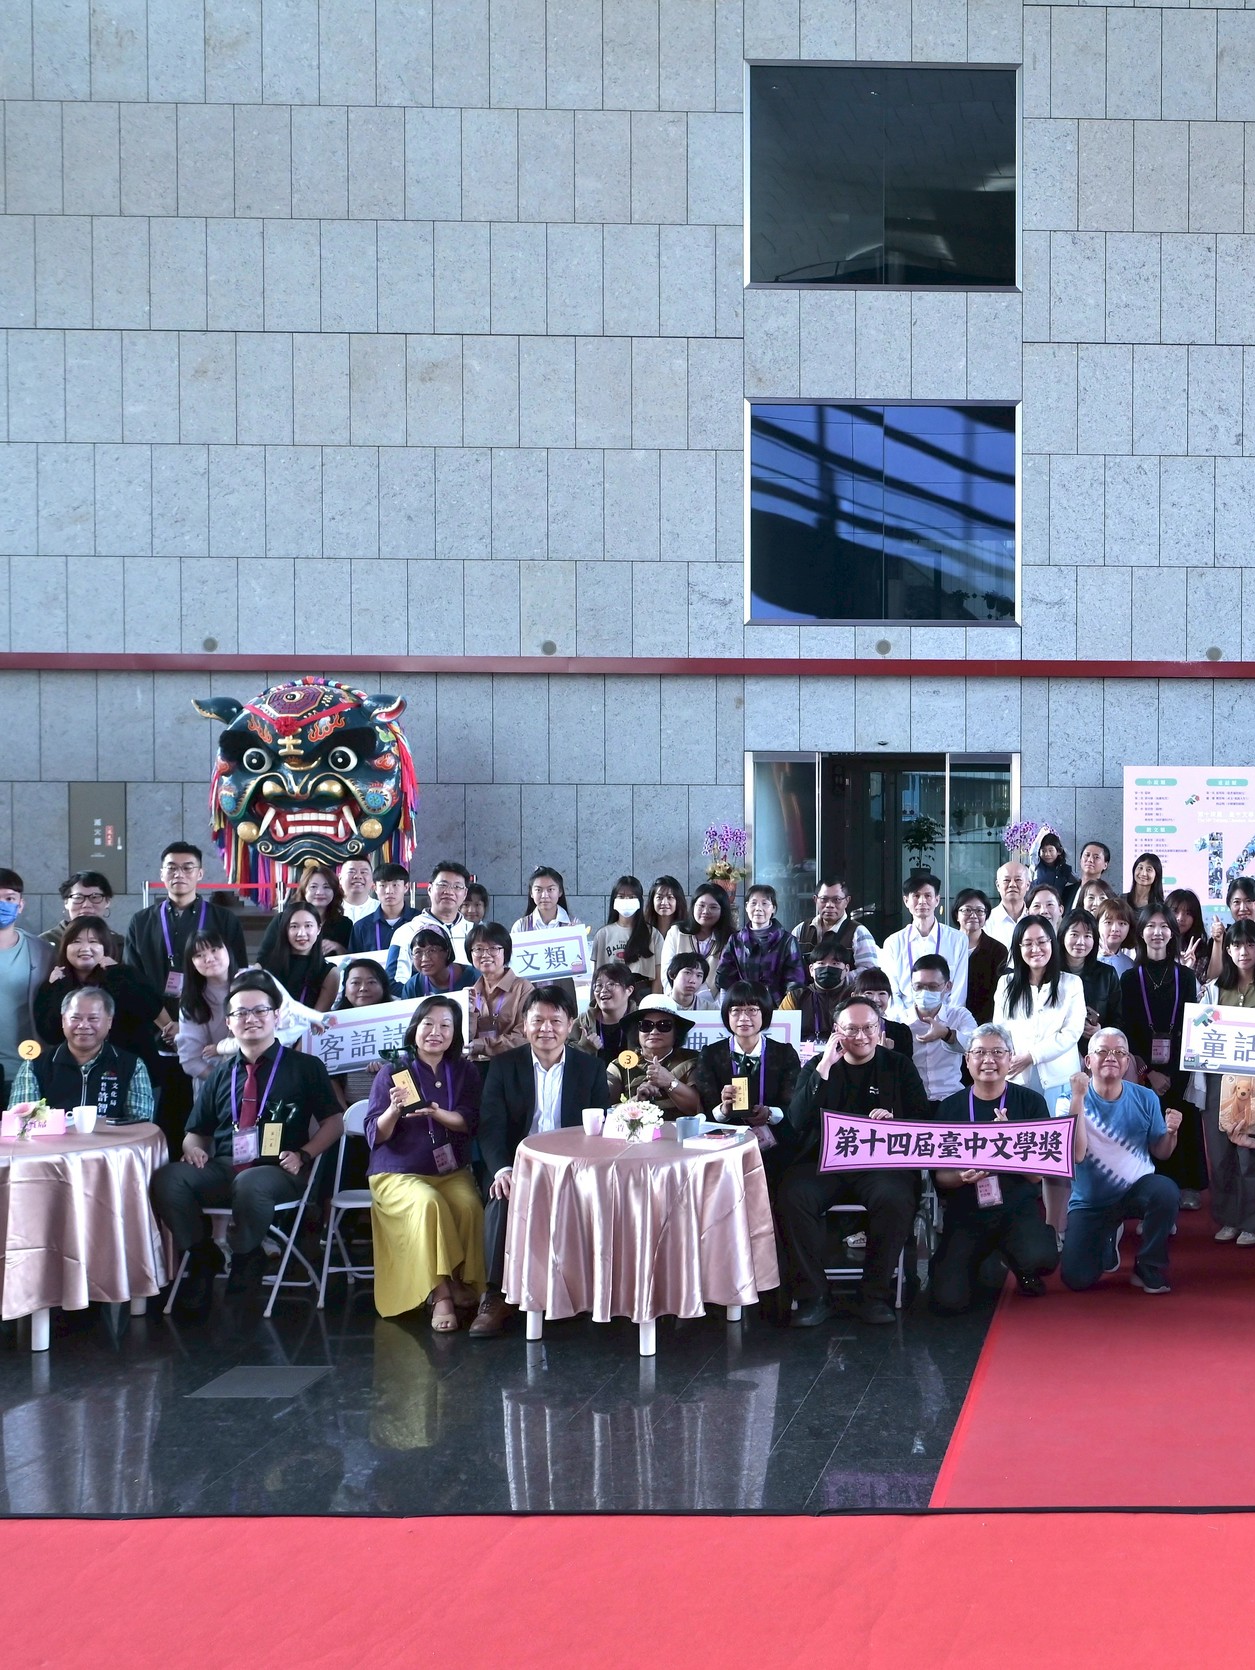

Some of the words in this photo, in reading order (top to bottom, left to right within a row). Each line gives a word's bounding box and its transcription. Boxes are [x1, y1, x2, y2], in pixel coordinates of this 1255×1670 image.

[516, 946, 568, 974] 文類
[25, 1044, 34, 1056] 2
[624, 1054, 632, 1065] 3
[97, 1091, 109, 1118] 許智
[834, 1126, 1063, 1164] 第十四屆臺中文學獎
